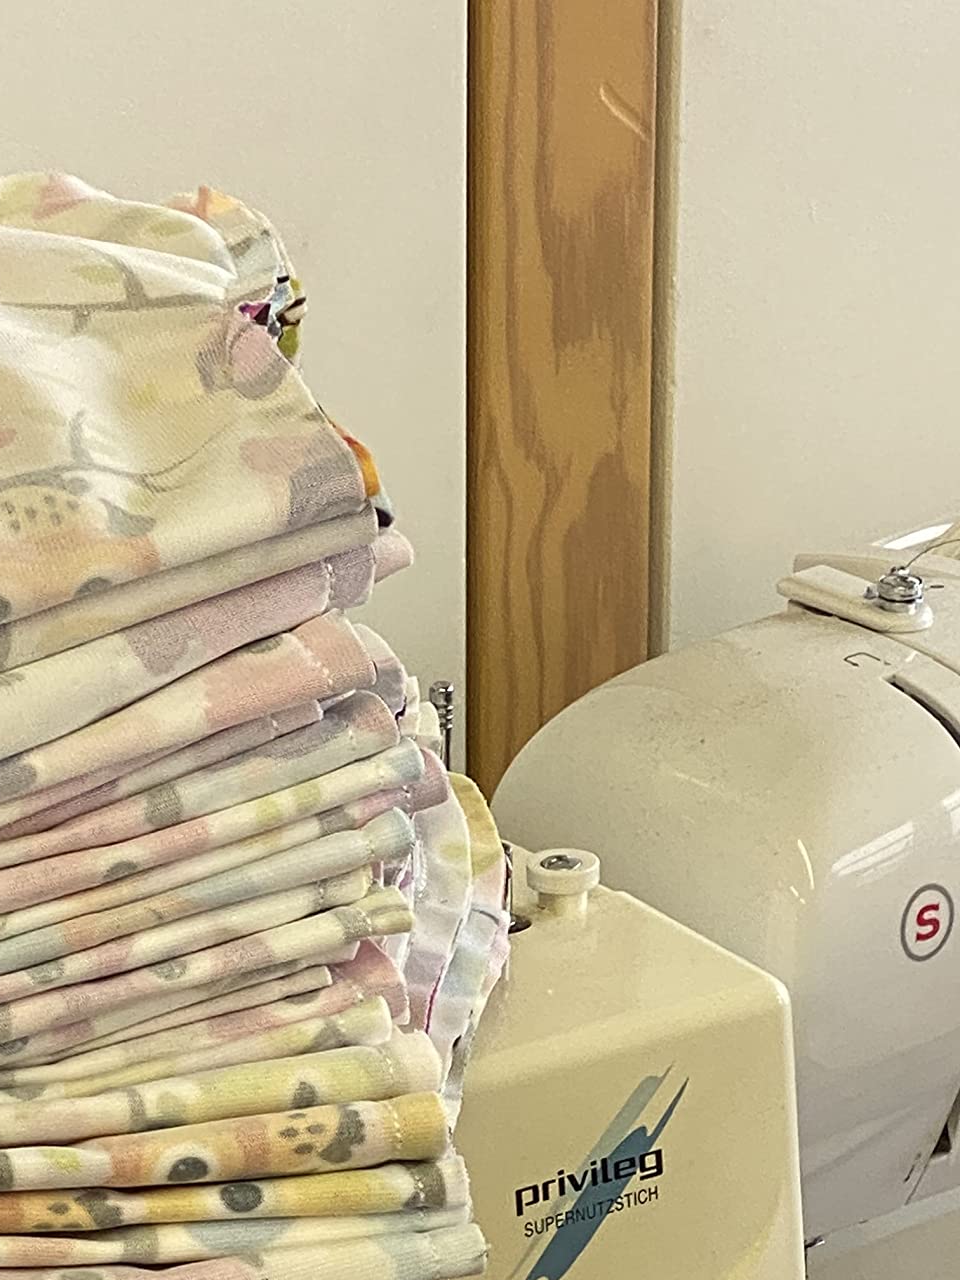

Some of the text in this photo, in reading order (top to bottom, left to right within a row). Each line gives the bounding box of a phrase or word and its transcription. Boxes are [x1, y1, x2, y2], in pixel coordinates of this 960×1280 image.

[915, 903, 940, 941] S
[515, 1149, 663, 1216] privileg
[524, 1186, 659, 1238] SUPERNUTZSTICH
